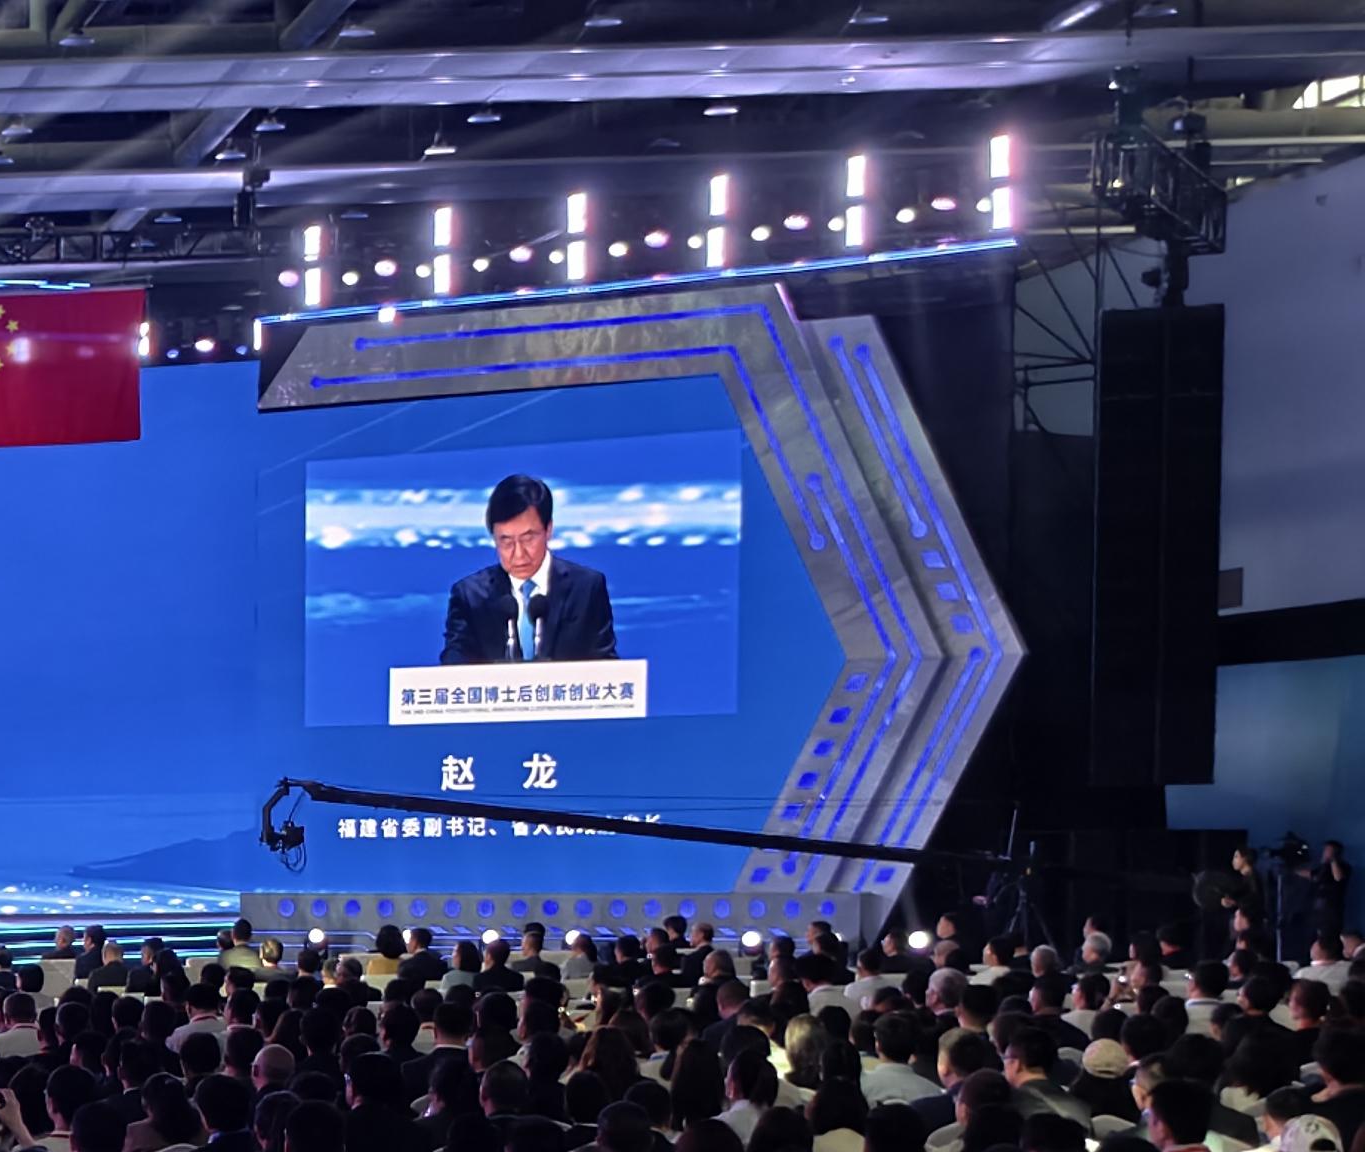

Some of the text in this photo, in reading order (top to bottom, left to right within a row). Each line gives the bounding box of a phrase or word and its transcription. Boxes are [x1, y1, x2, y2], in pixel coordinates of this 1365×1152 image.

[401, 682, 635, 706] 第三届全国博士后创新创业大赛
[441, 753, 558, 792] 赵龙
